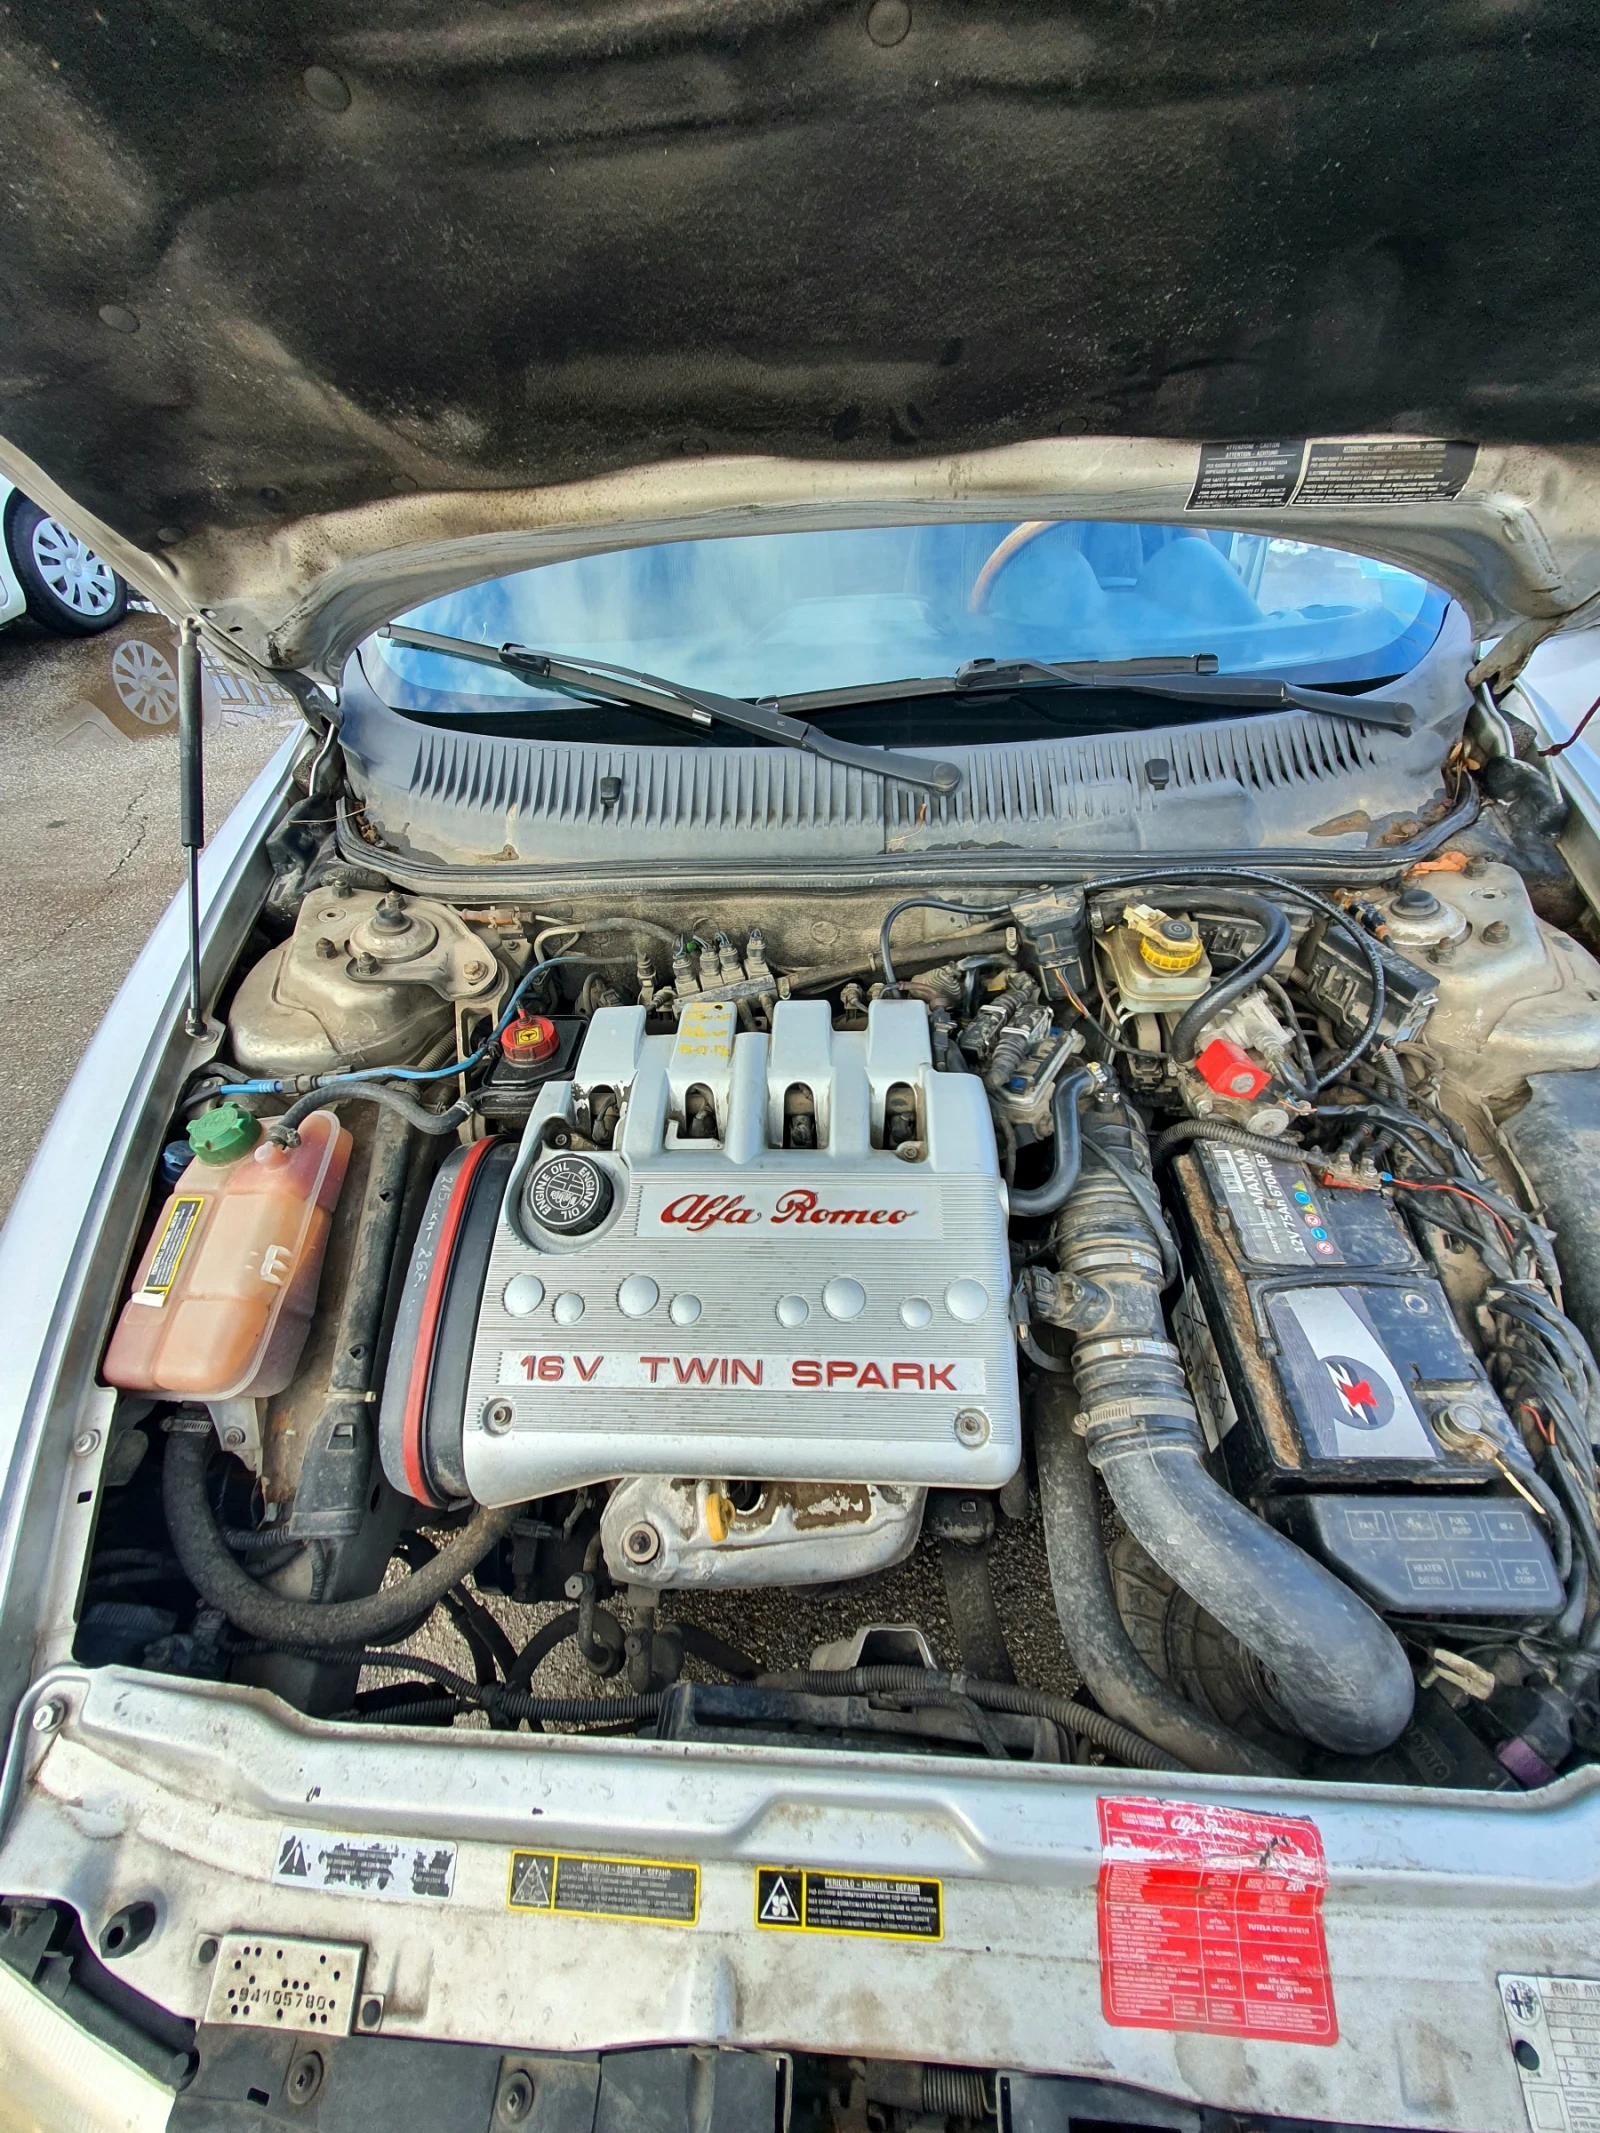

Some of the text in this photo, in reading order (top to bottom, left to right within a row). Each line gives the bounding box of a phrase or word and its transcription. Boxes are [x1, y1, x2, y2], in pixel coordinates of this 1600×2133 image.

[1233, 1148, 1264, 1206] MAXIMA
[1262, 1169, 1283, 1197] 670A
[535, 1173, 552, 1215] ENGINE
[551, 1162, 570, 1175] OIL
[578, 1166, 595, 1209] ENGINE
[561, 1207, 580, 1220] OIL
[660, 1189, 919, 1232] Alfa Romeo
[1276, 1199, 1297, 1229] 75Ah
[1286, 1230, 1307, 1255] 12V
[640, 1356, 762, 1387] TWIN
[791, 1359, 958, 1391] SPARK
[1413, 1563, 1443, 1573] HEATER
[1466, 1569, 1481, 1579] FAN
[1418, 1576, 1445, 1585] DIESEL
[617, 1864, 641, 1876] DANGER
[825, 1878, 855, 1888] PERICOLO
[862, 1879, 888, 1890] DANGER
[1248, 1923, 1271, 1932] TUTELA
[1262, 1954, 1285, 1963] TUTELA
[1257, 1983, 1275, 1991] BRAKE
[238, 1987, 326, 2010] 94105780
